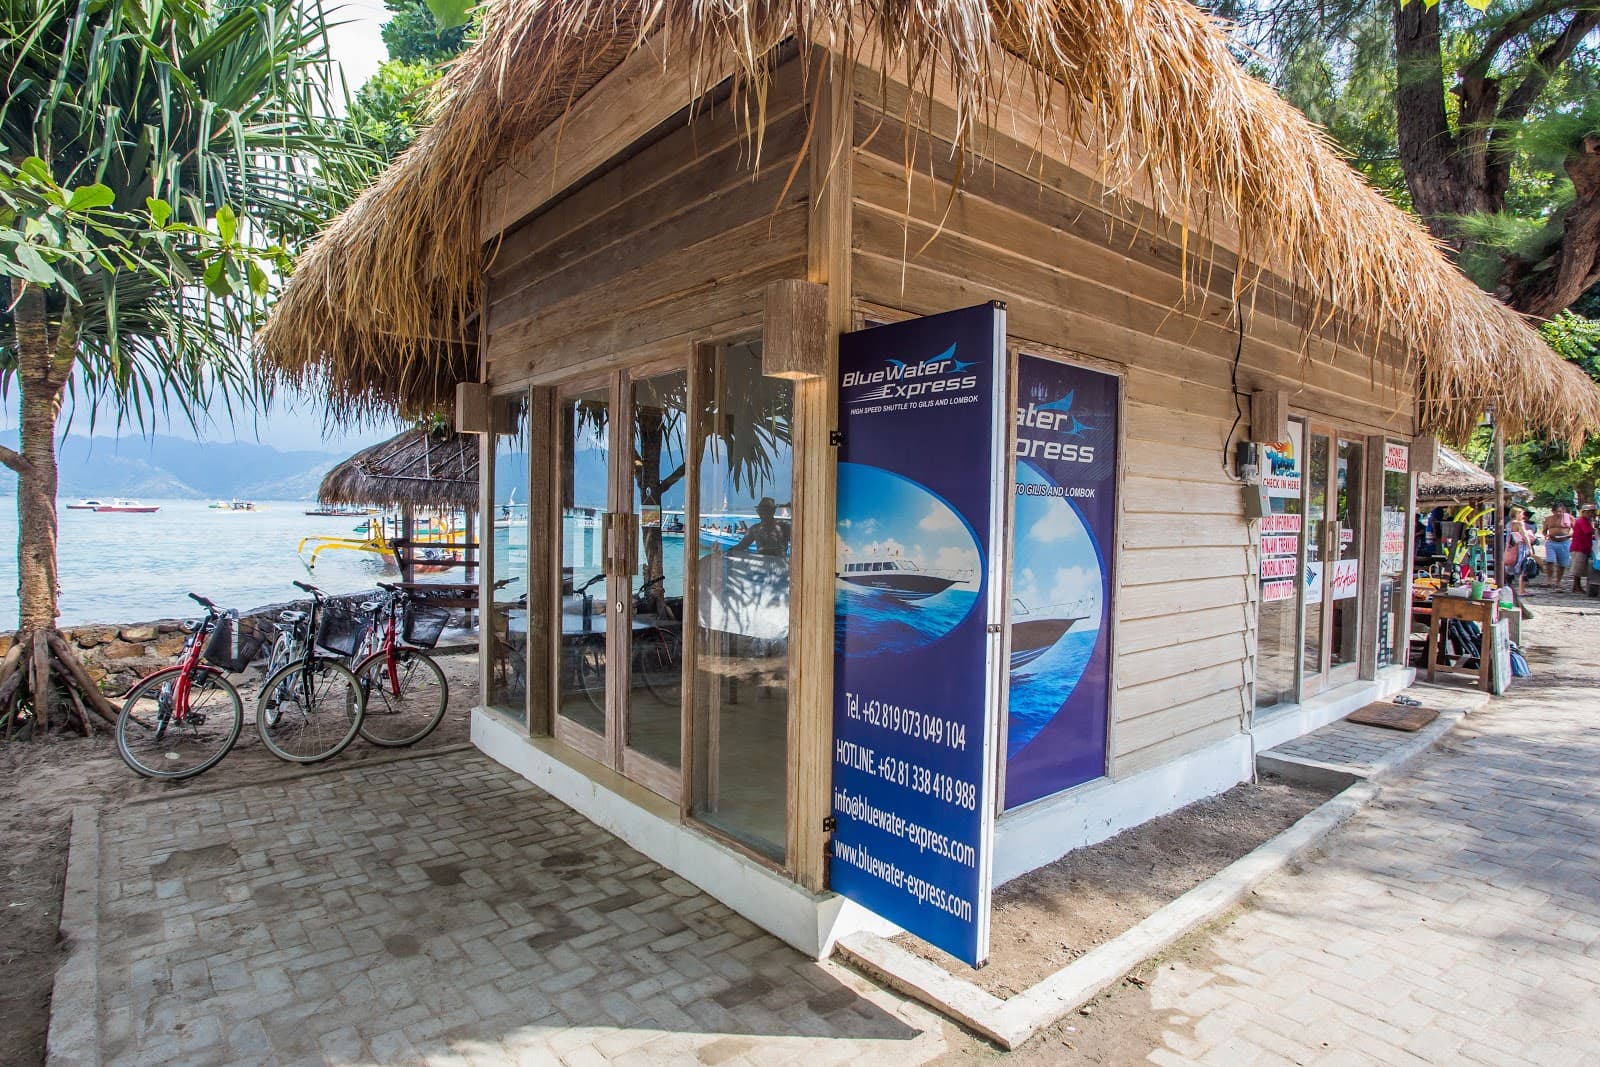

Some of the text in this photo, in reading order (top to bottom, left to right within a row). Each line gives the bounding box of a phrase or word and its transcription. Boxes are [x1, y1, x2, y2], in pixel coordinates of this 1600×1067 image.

[842, 360, 952, 388] BlueWater
[880, 375, 977, 399] Express
[850, 395, 979, 416] HIGH SPEED SHUTTLE TO GILIS AND LOMBOK
[1016, 402, 1068, 431] ater
[1016, 438, 1095, 463] press
[1384, 455, 1407, 470] CHANGER
[1388, 447, 1403, 458] MONEY
[1026, 483, 1047, 496] GILIS
[1047, 486, 1064, 497] AND
[1065, 487, 1096, 498] LOMBOK
[1262, 478, 1300, 490] CHECK IN HERE
[846, 692, 966, 752] Tel. +62 819 073 049 104
[836, 739, 976, 811] HOTLINE. +62 81 338 418 988
[834, 786, 976, 869] info@bluewater-express.com
[834, 839, 972, 923] www.bluewater-express.com
